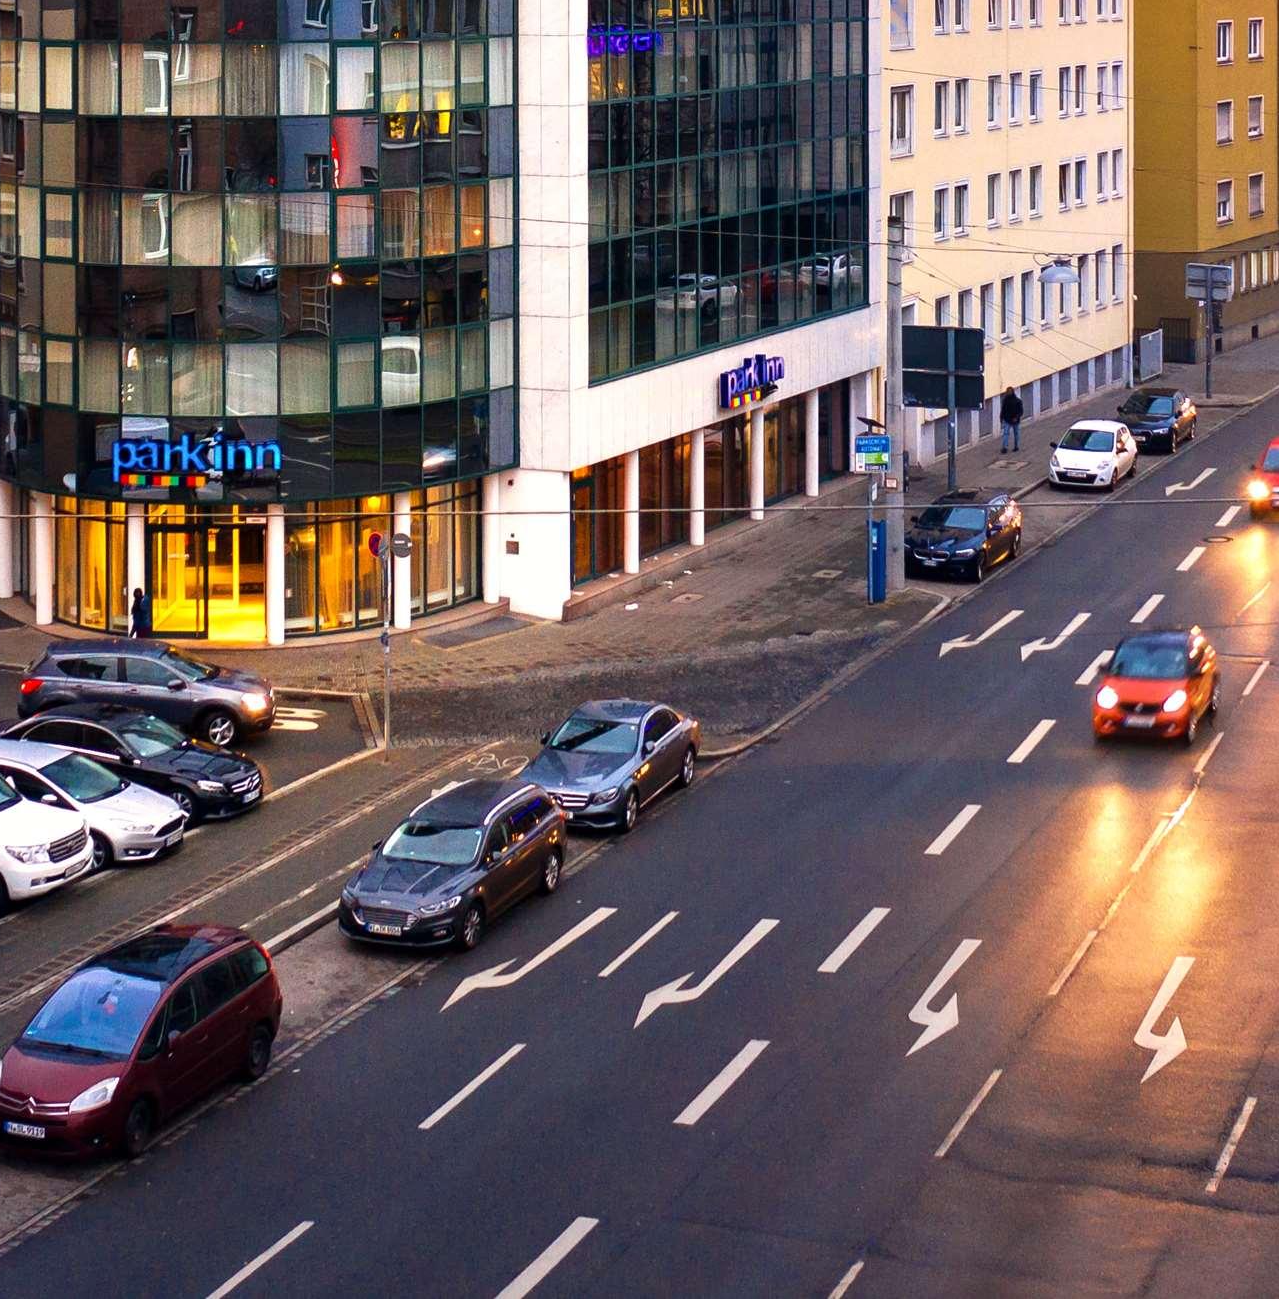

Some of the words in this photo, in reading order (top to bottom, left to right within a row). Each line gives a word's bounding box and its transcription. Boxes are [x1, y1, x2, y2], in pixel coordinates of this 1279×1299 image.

[721, 358, 760, 408] park
[756, 354, 784, 384] inn
[112, 432, 205, 482] park
[214, 433, 282, 471] inn
